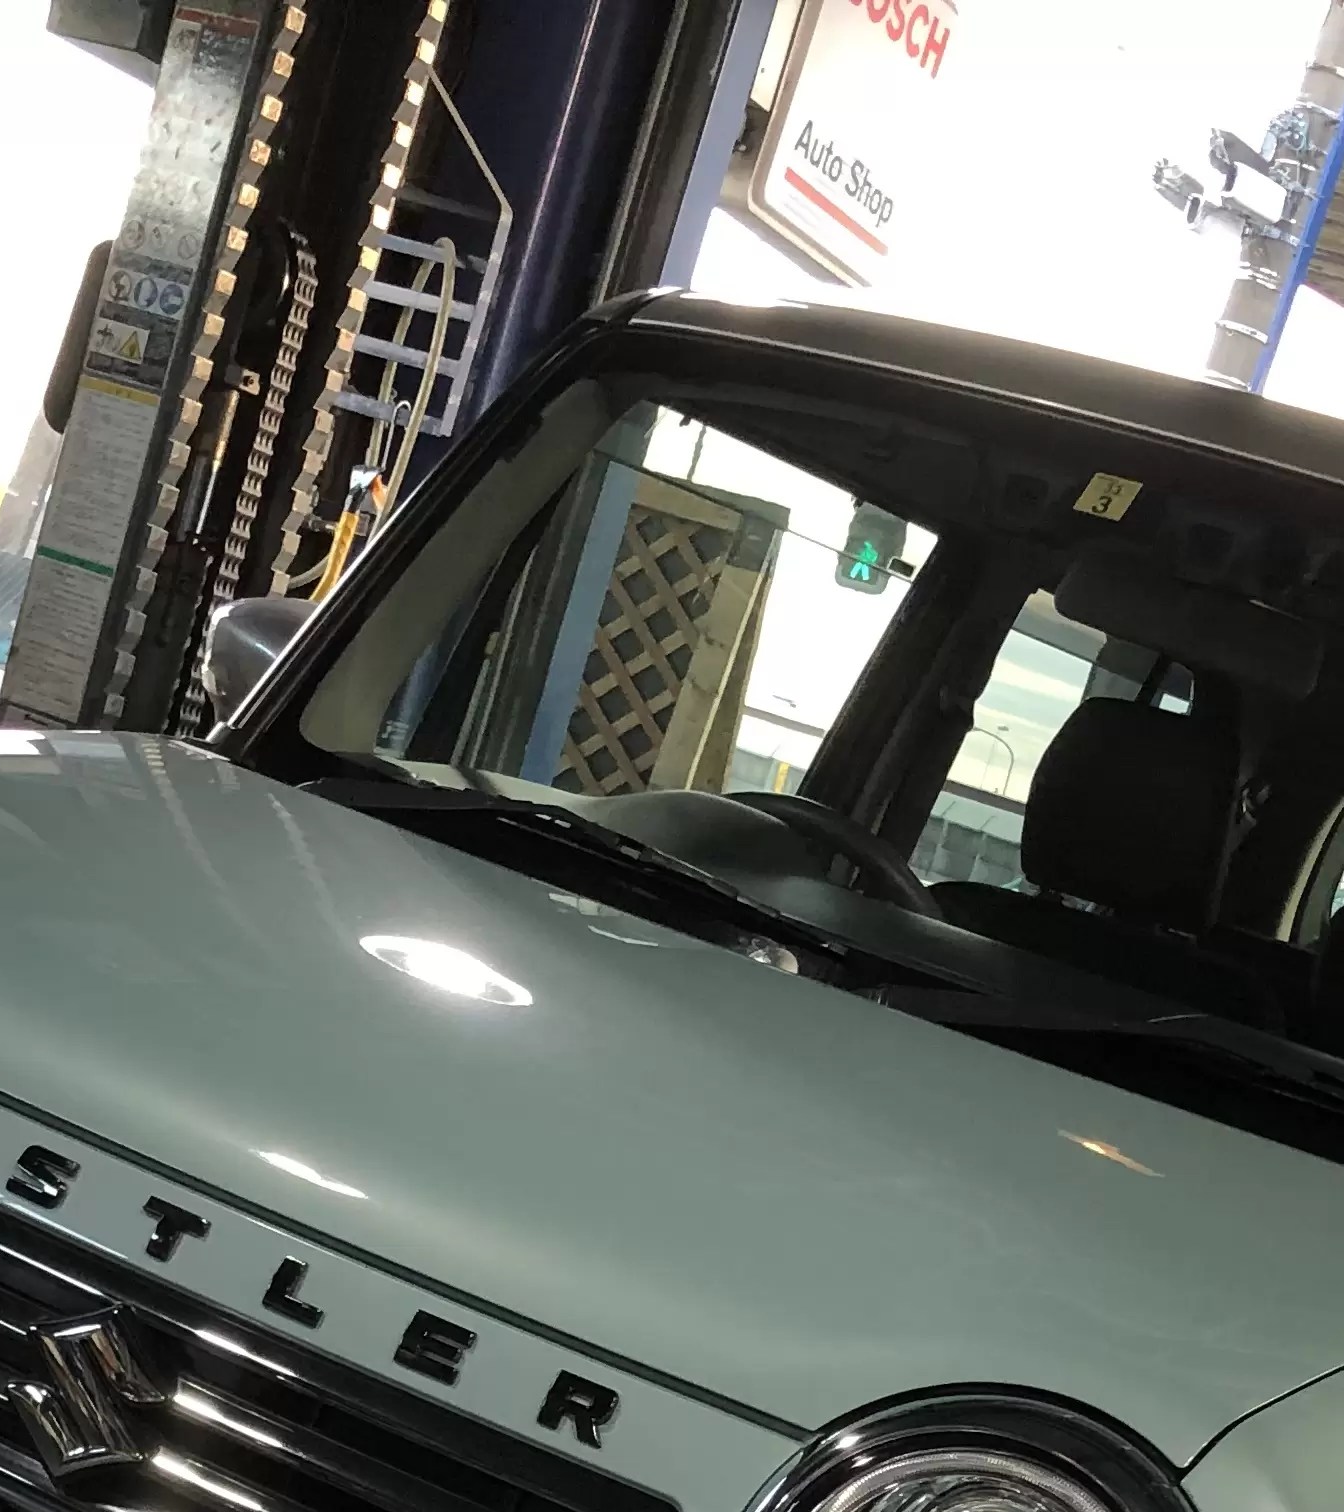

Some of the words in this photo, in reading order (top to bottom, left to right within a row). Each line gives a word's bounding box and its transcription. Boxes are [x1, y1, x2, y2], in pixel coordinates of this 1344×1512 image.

[794, 119, 843, 182] Auto
[844, 159, 894, 228] Shop
[1091, 495, 1113, 514] 3
